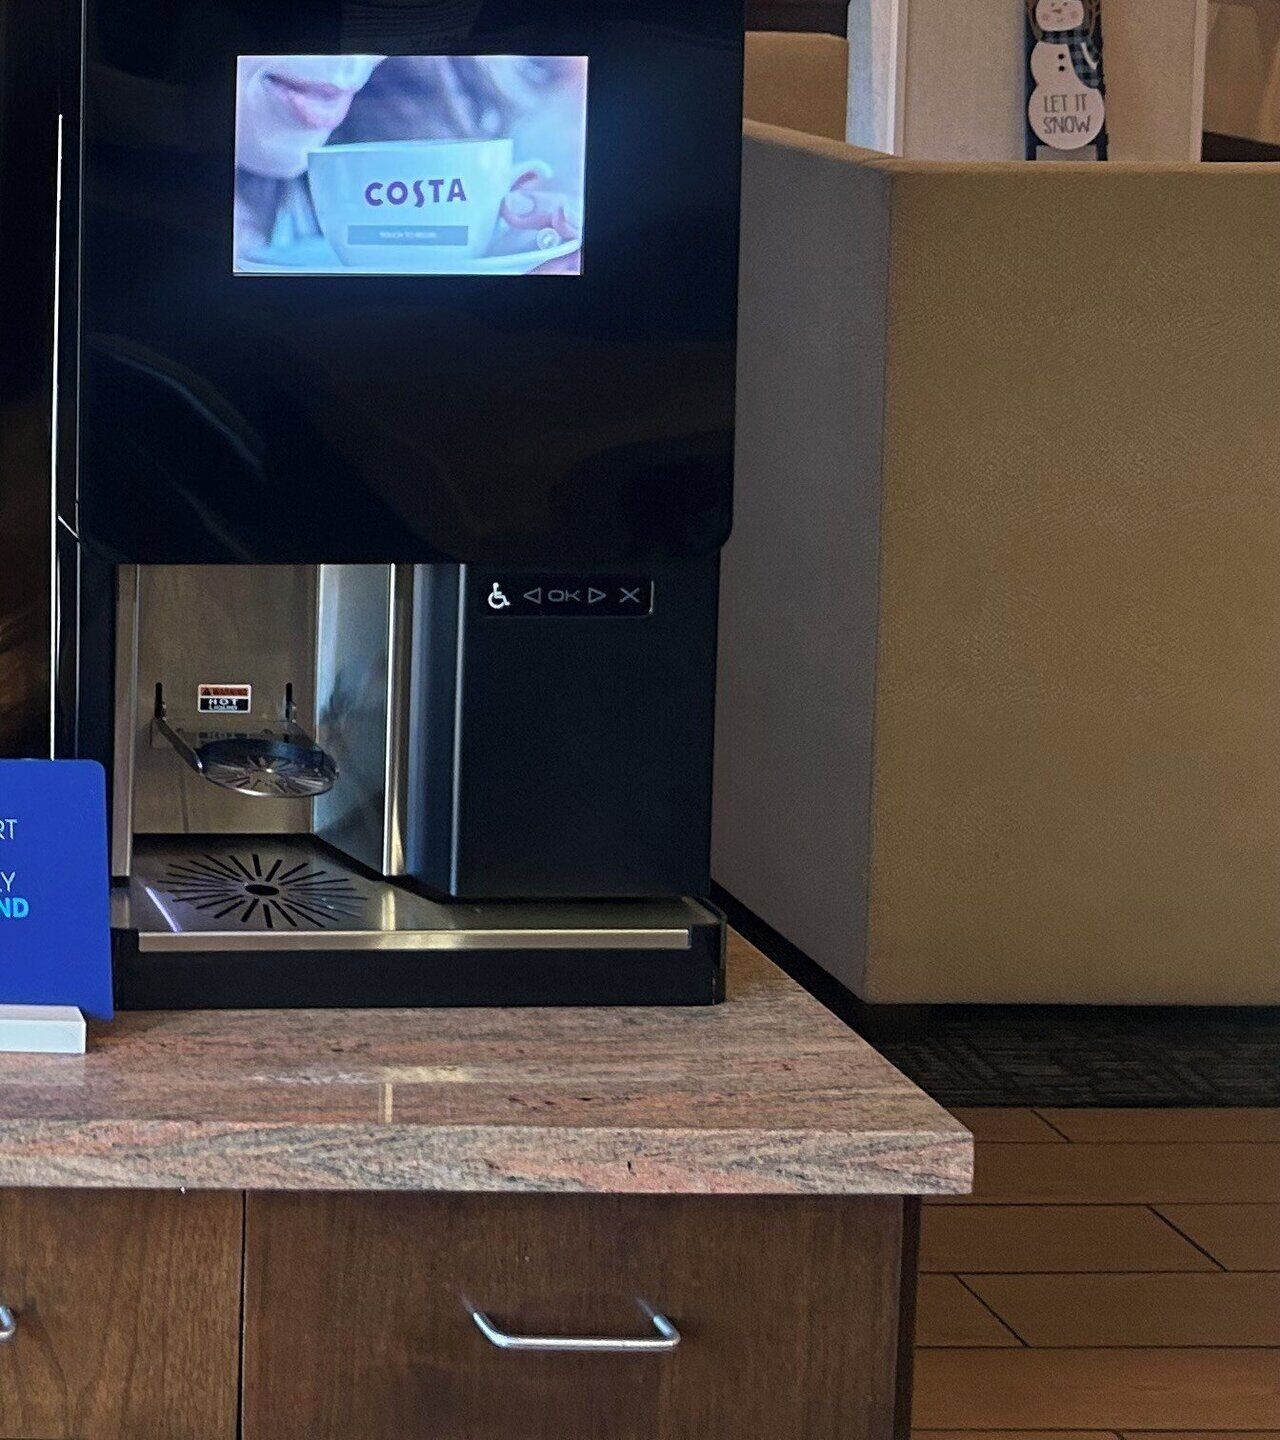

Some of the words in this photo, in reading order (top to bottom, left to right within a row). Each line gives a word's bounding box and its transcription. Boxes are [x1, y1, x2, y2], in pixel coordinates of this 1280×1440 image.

[1043, 94, 1068, 113] LET
[1075, 93, 1088, 112] IT
[1043, 115, 1092, 134] SNOW
[365, 178, 467, 208] COSTA
[547, 589, 581, 602] OK
